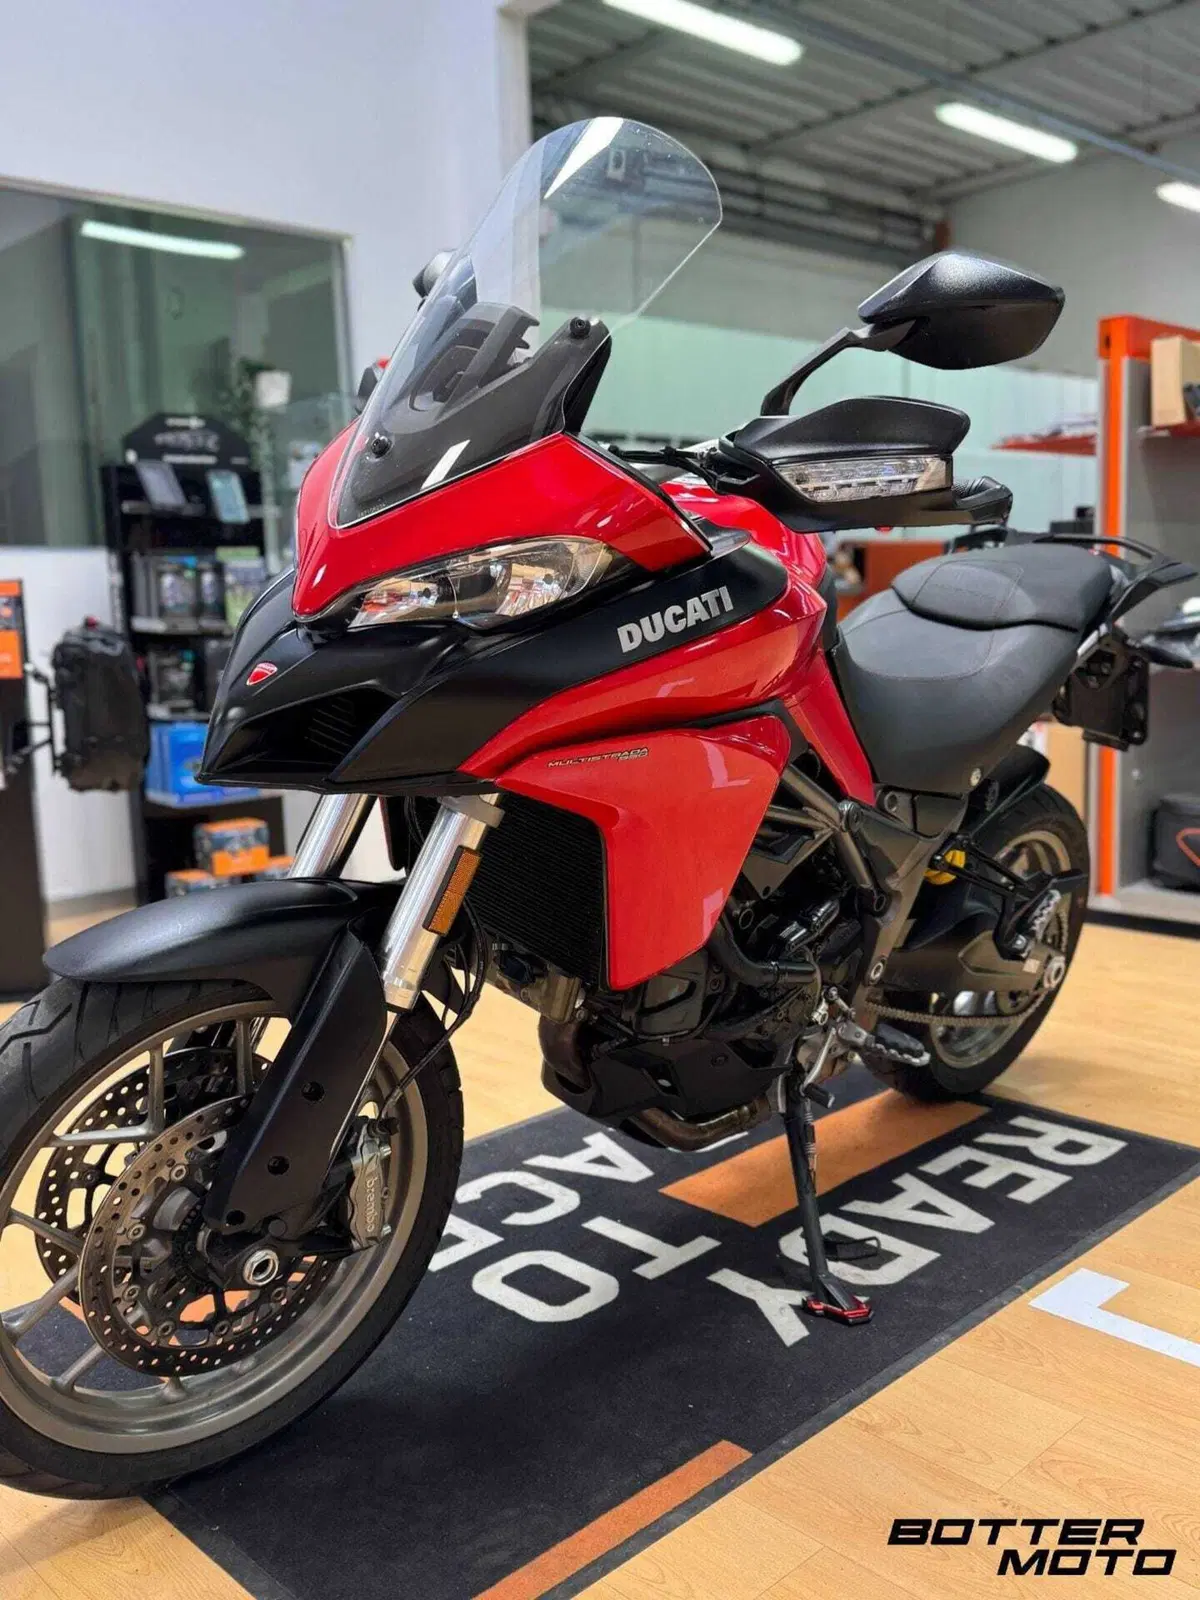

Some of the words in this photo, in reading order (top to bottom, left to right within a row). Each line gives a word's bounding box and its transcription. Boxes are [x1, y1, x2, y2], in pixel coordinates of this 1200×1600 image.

[617, 585, 734, 653] DUCATI
[547, 747, 648, 767] MULTISTRADA
[366, 1177, 378, 1232] brembo
[427, 1131, 748, 1272] AC
[706, 1115, 1128, 1347] READY
[471, 1215, 722, 1323] TO
